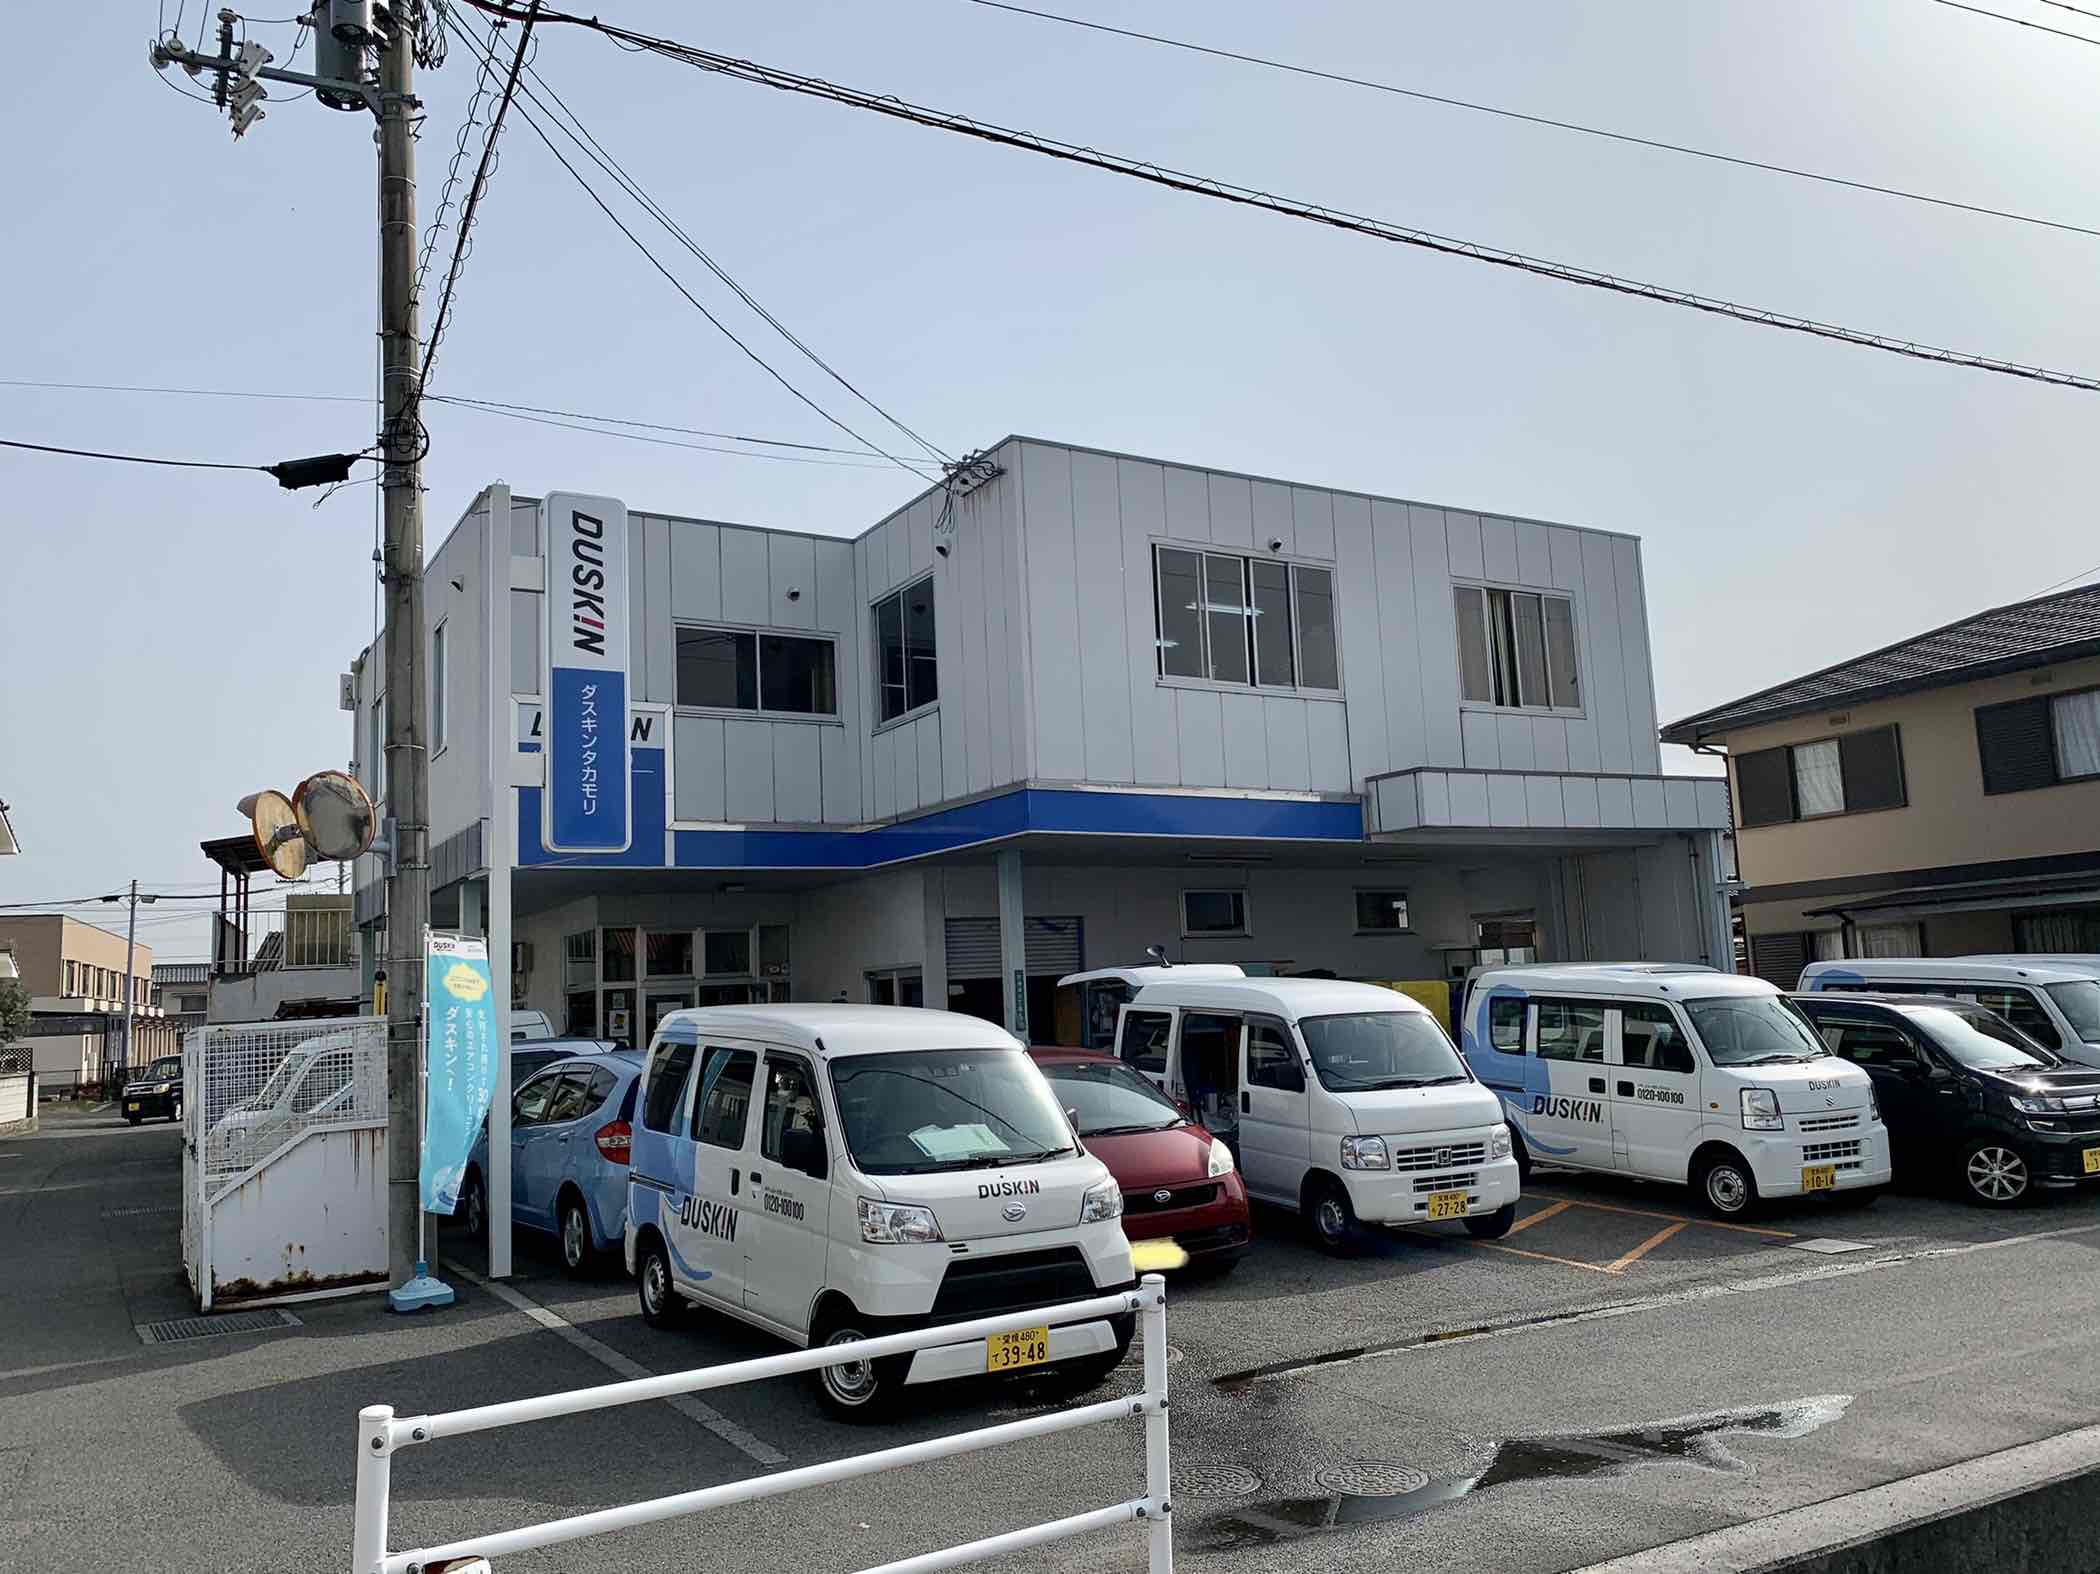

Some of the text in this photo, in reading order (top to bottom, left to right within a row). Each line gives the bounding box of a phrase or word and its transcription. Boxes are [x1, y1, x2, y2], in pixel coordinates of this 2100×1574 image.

[572, 509, 605, 656] DUSKIN
[581, 684, 598, 815] ダスキンタカモリ
[1808, 1079, 1841, 1091] DUSKIN
[1534, 1095, 1601, 1123] DUSKIN
[978, 1179, 1040, 1199] DUSKIN
[680, 1195, 738, 1242] DUSKIN
[1437, 1200, 1466, 1217] 27-28
[1001, 1341, 1046, 1367] 39-48
